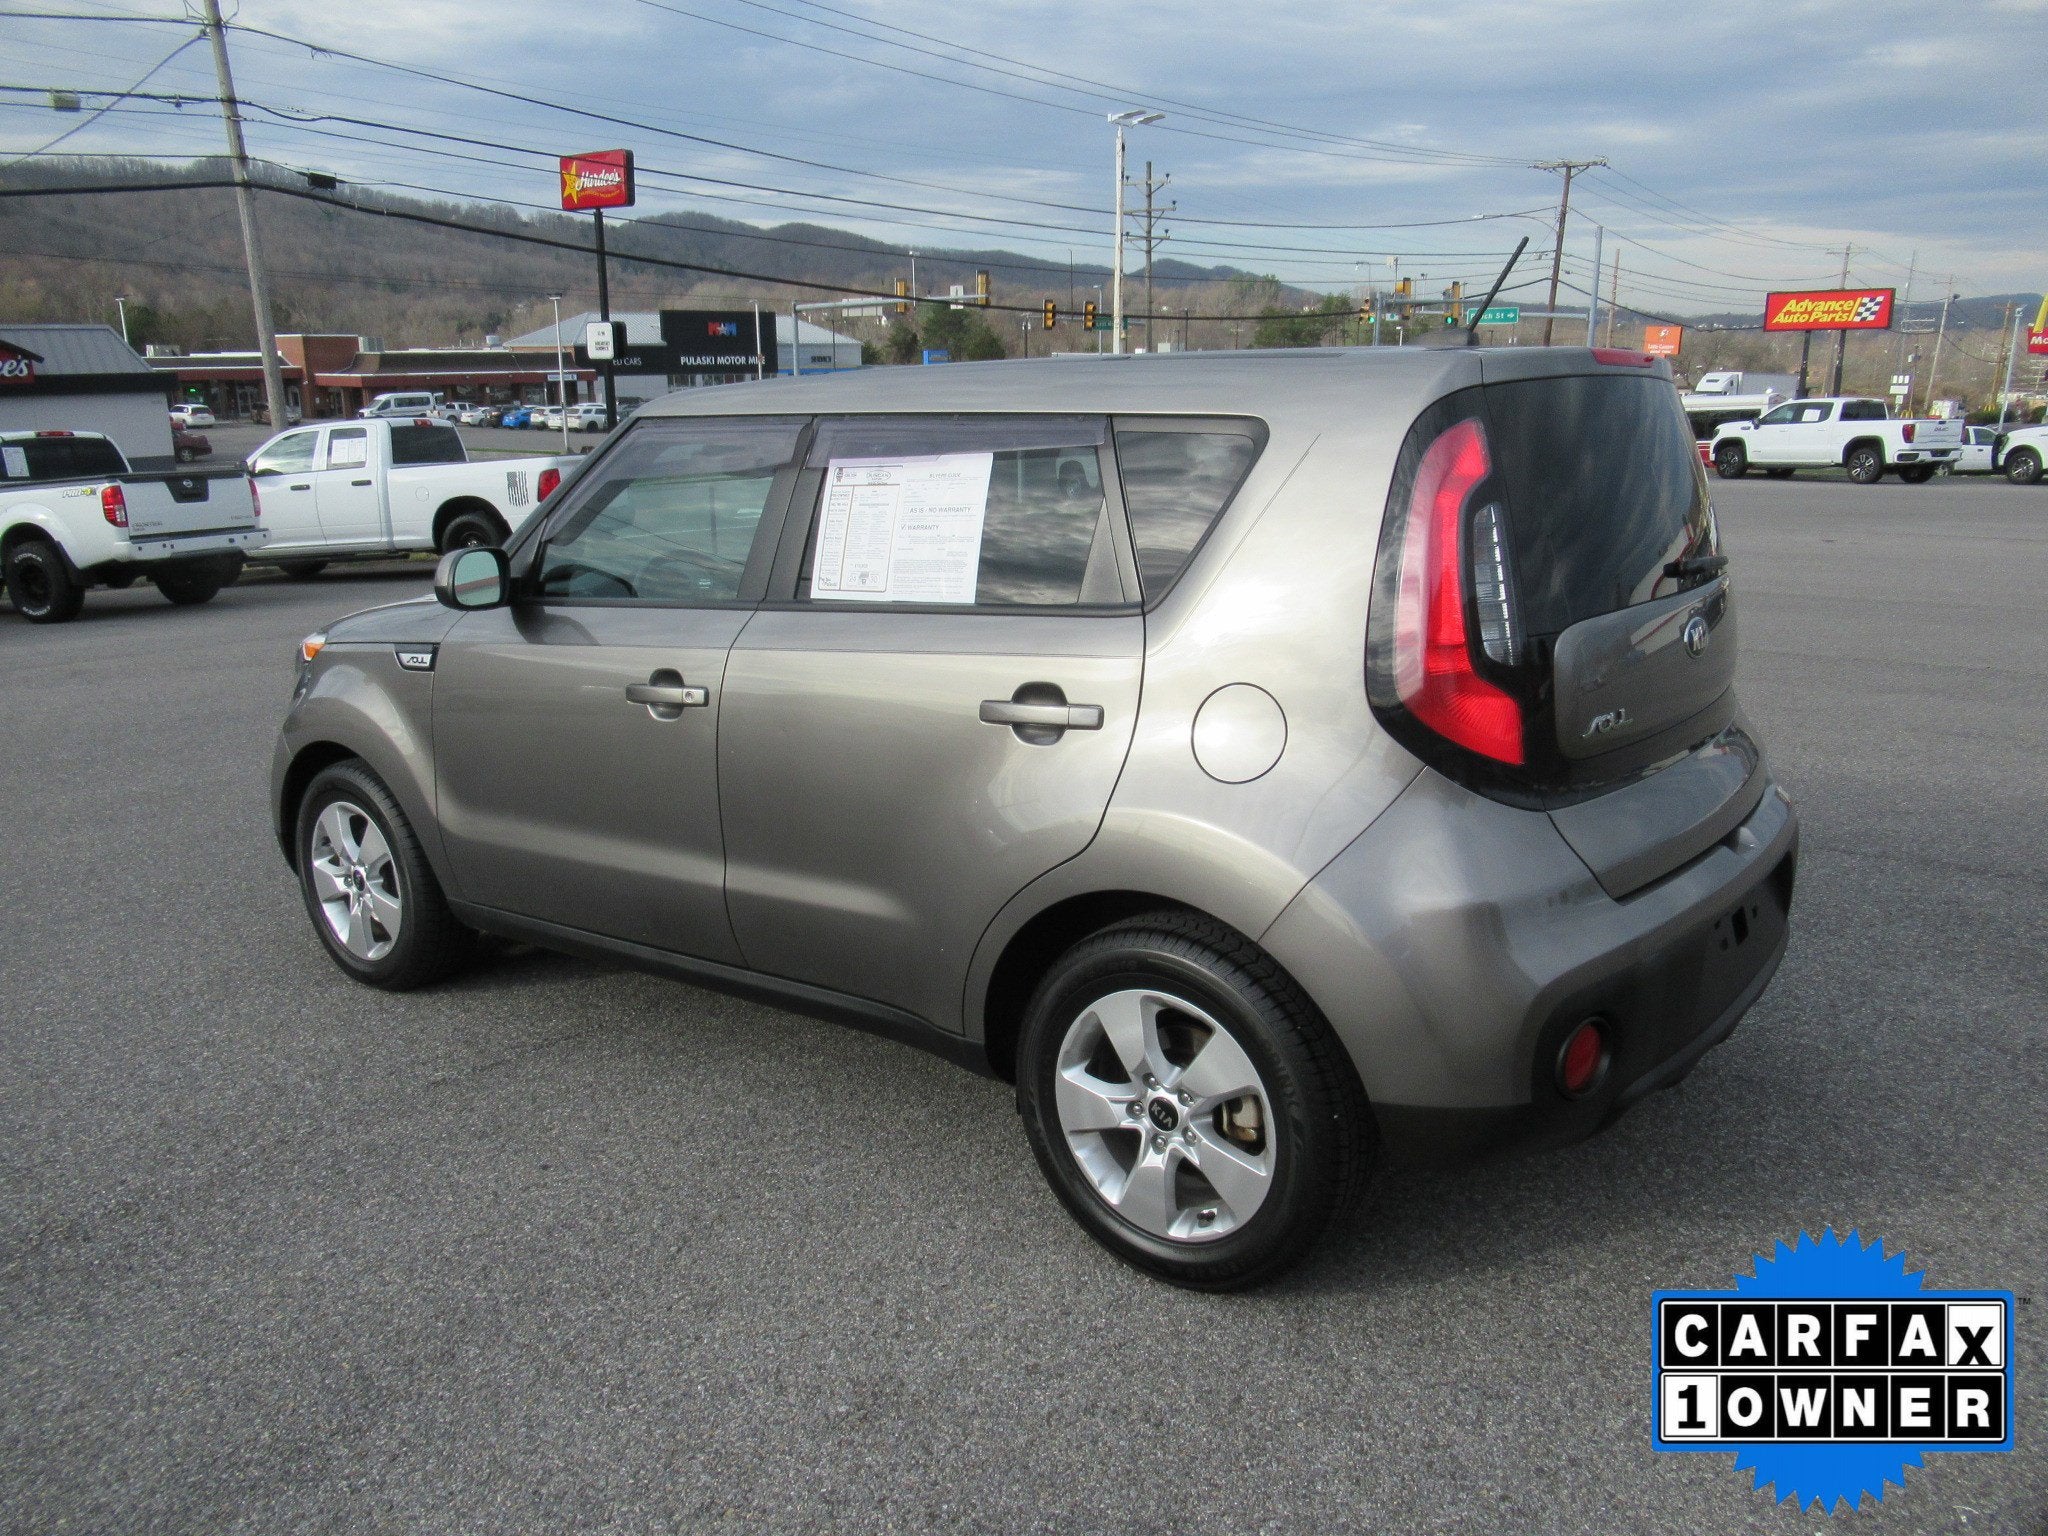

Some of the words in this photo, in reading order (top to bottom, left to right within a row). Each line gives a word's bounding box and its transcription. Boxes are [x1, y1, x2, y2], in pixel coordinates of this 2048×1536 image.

[576, 169, 621, 190] Hardee's
[1781, 298, 1854, 312] Advance
[1772, 312, 1808, 323] Auto
[1809, 311, 1849, 322] Parts
[0, 354, 28, 377] e's
[624, 357, 641, 366] CARS
[681, 356, 715, 365] PULASKI
[717, 356, 746, 365] MOTOR
[749, 356, 765, 365] MIE
[1151, 1102, 1172, 1128] KIA
